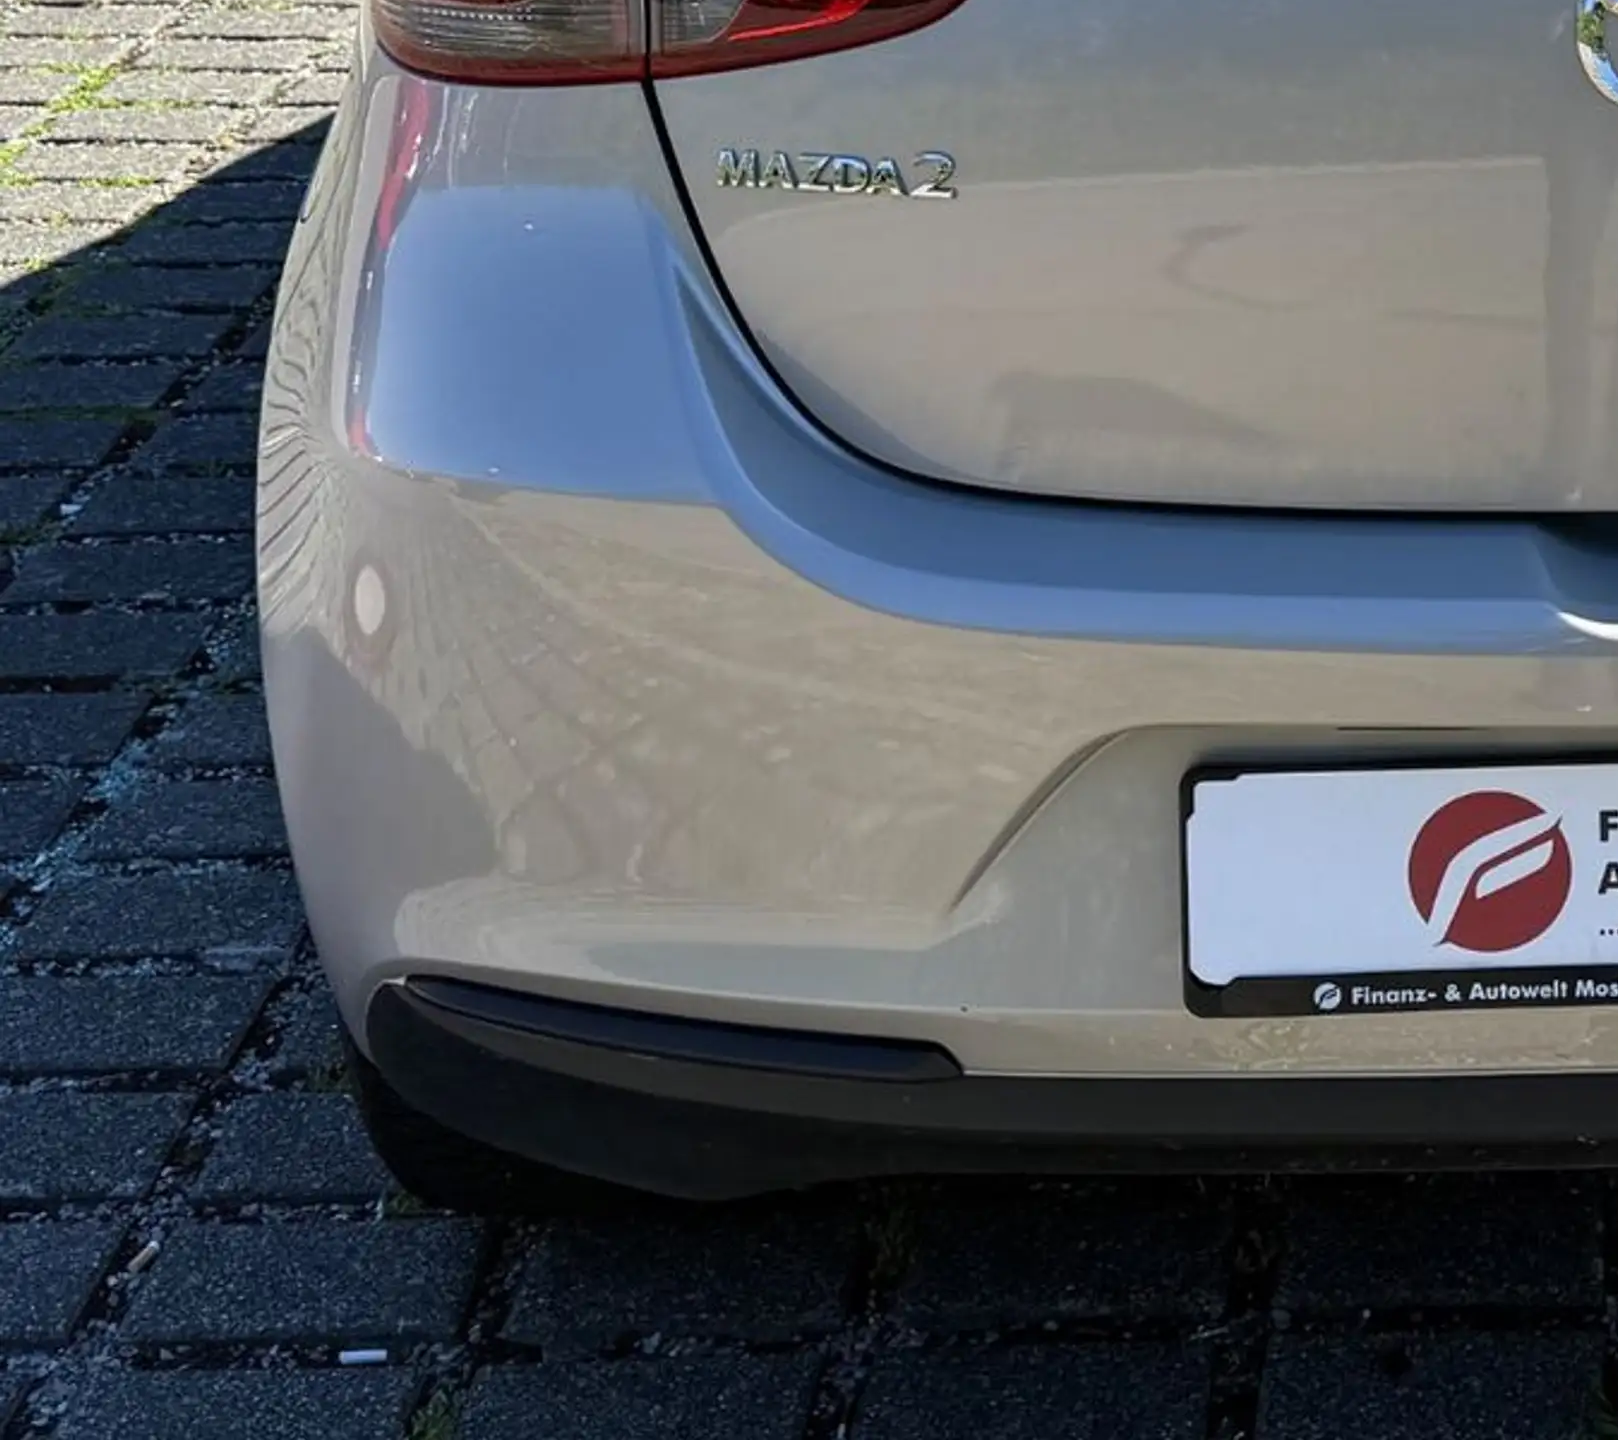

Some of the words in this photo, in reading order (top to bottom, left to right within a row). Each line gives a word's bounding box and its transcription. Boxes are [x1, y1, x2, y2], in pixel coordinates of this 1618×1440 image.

[1351, 986, 1436, 1006] Finanz-
[1444, 984, 1462, 1002] &
[1468, 981, 1568, 1001] Autowelt
